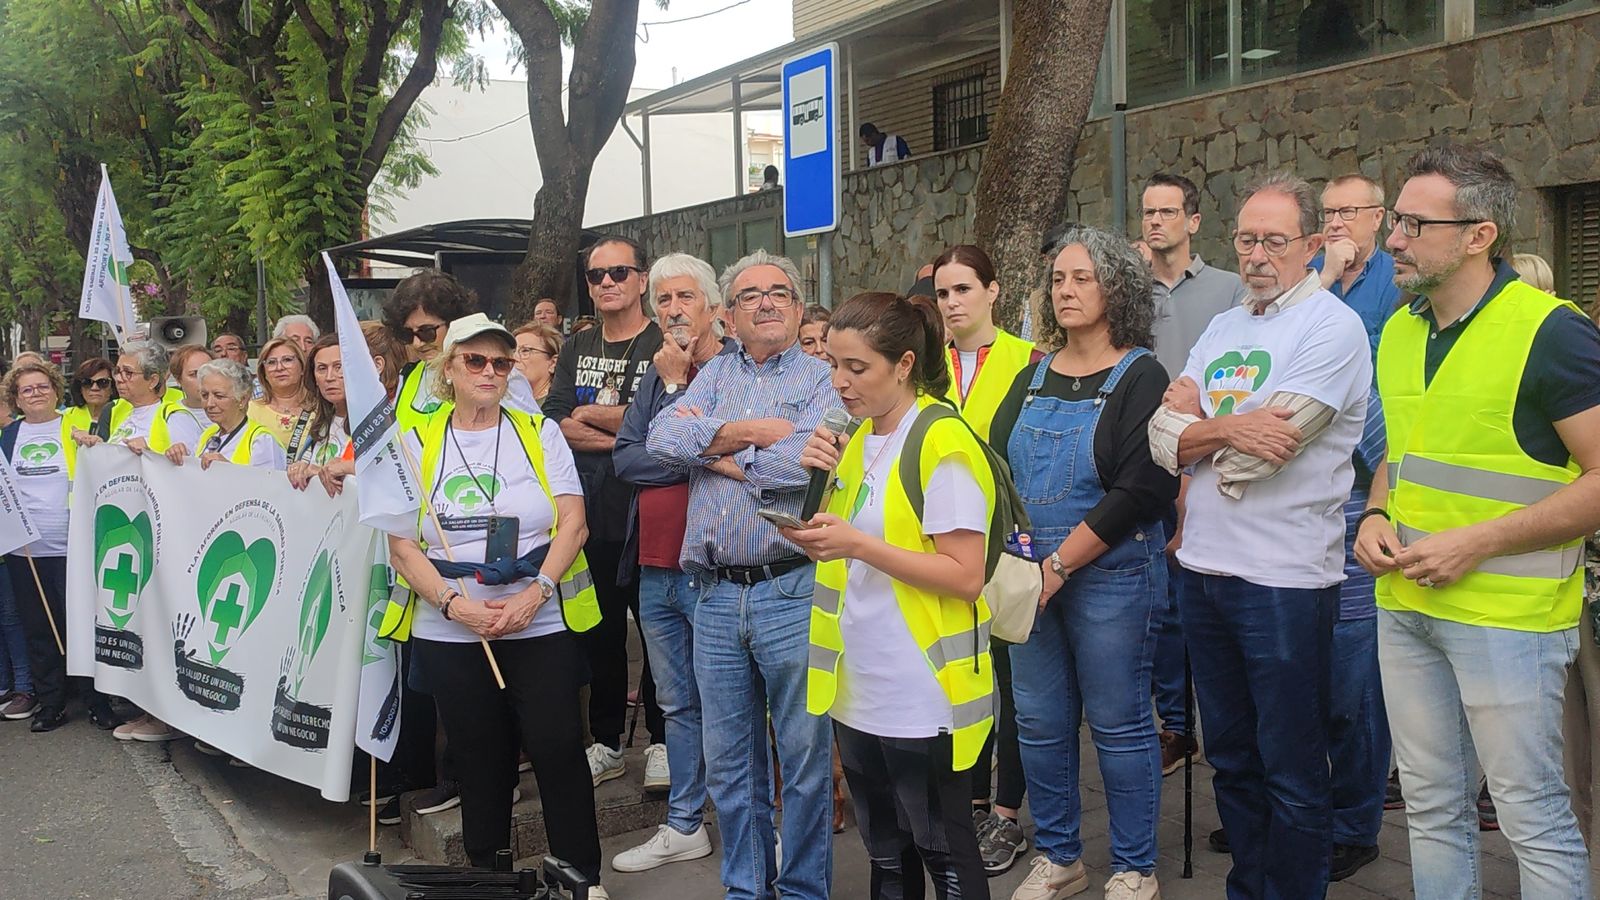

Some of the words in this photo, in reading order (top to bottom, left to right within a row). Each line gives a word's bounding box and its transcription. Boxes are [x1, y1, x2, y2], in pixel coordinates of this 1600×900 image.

[108, 475, 139, 488] DEFENSA
[187, 517, 224, 574] PLATAFORMA
[224, 508, 234, 519] EN
[234, 499, 261, 512] DEFENSA
[261, 501, 270, 511] DE
[269, 505, 277, 516] LA
[107, 637, 118, 646] ES
[119, 639, 128, 648] UN
[100, 648, 111, 657] UN
[185, 668, 202, 681] SALUD
[201, 673, 210, 684] ES
[210, 676, 219, 687] UN
